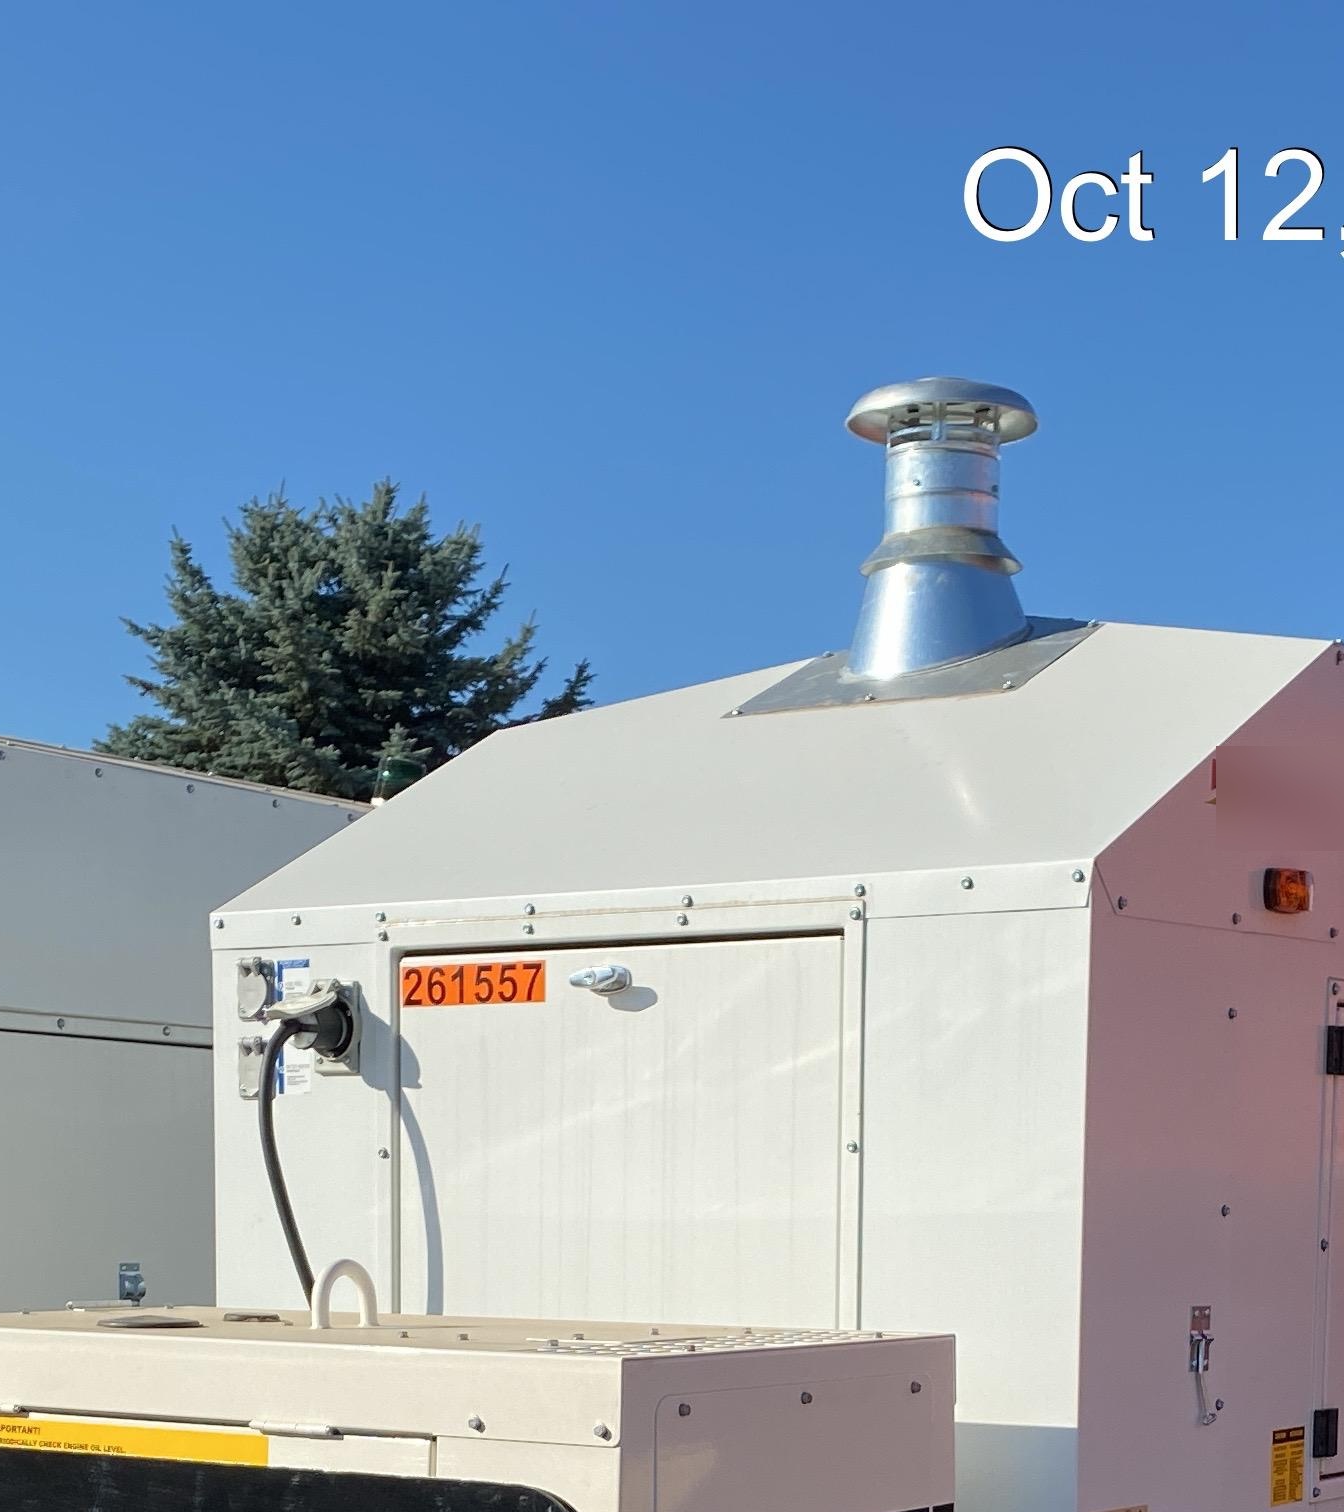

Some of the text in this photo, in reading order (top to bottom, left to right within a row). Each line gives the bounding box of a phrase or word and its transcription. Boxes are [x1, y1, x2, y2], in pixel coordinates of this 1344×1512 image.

[403, 962, 543, 1006] 261557
[38, 1440, 62, 1450] CHECK
[63, 1442, 89, 1452] ENGINE
[90, 1445, 102, 1453] OIL
